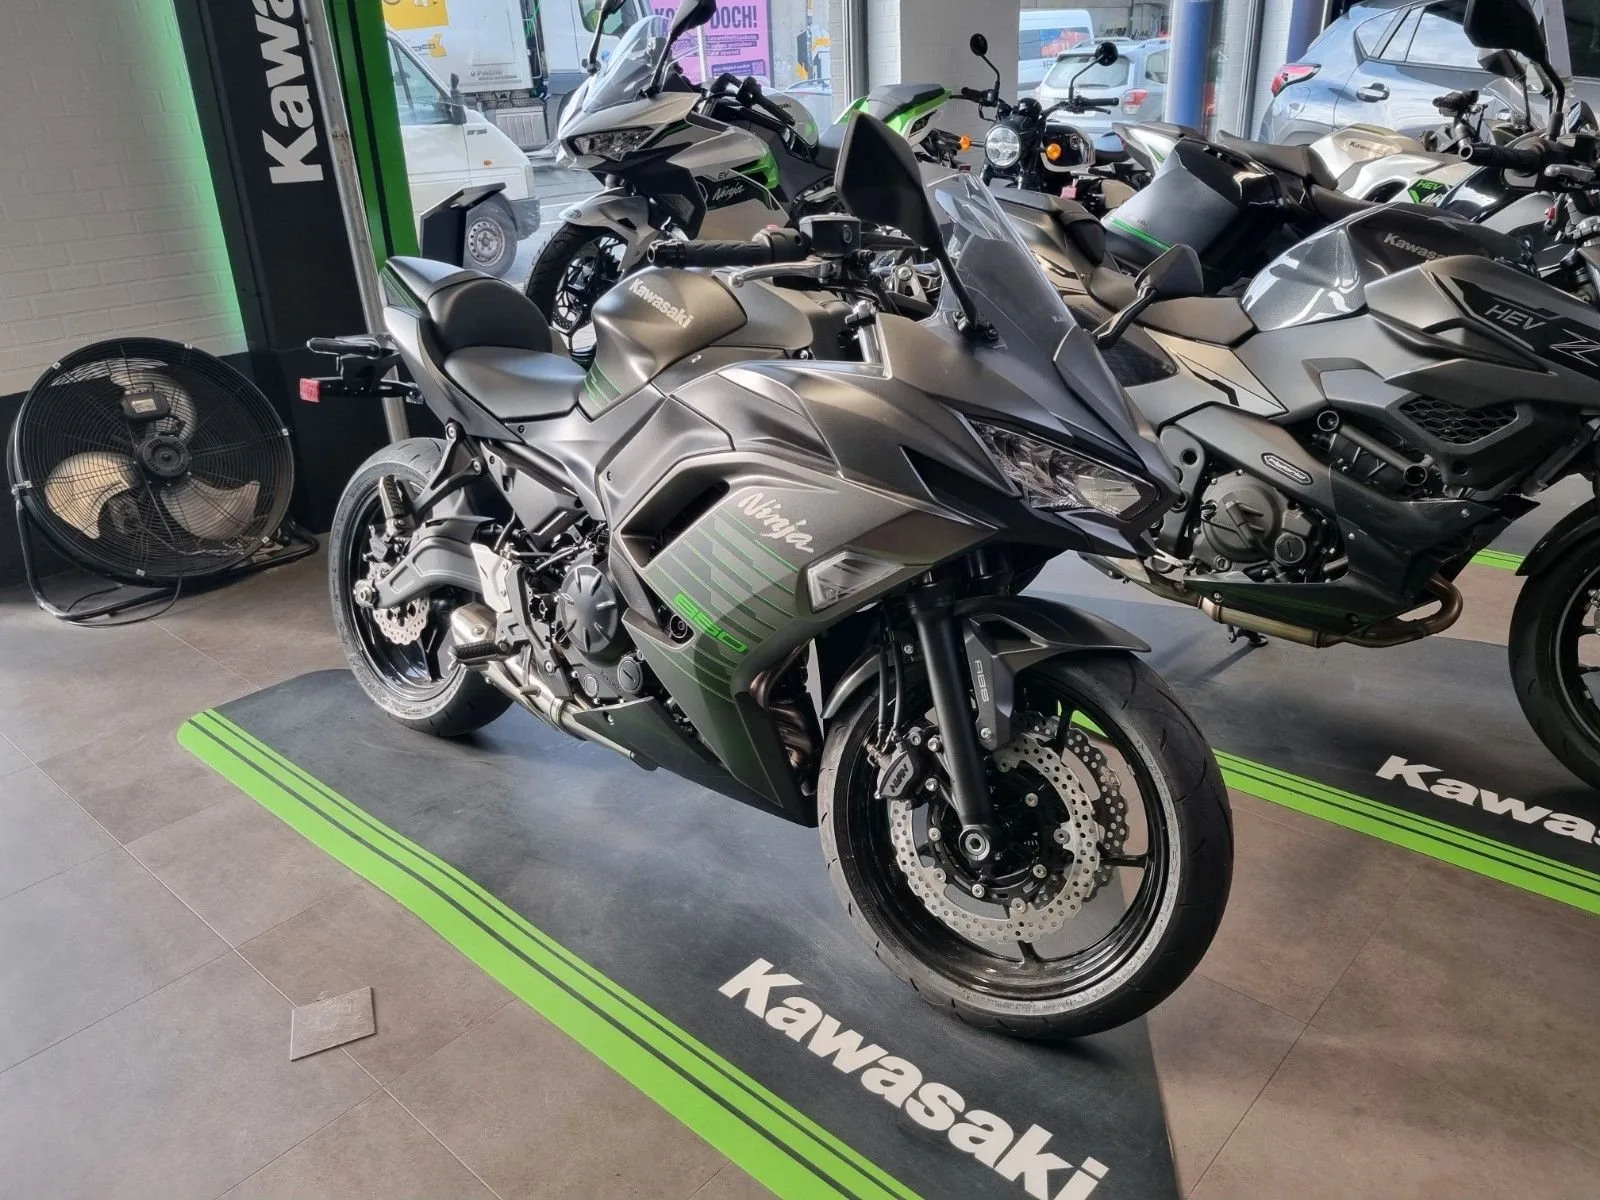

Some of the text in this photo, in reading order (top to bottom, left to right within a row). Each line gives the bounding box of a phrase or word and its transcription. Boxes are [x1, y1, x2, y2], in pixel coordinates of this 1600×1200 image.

[710, 5, 758, 29] DOCH!
[711, 182, 745, 201] Ninja
[1416, 180, 1444, 190] HEV
[1383, 232, 1445, 262] Kawas
[629, 277, 695, 329] Kawasaki
[1484, 304, 1547, 330] HEV
[737, 492, 815, 554] Ninja
[673, 592, 748, 653] 650
[974, 659, 990, 703] ABS
[1375, 755, 1600, 847] Kawa
[717, 957, 1110, 1200] Kawasaki
